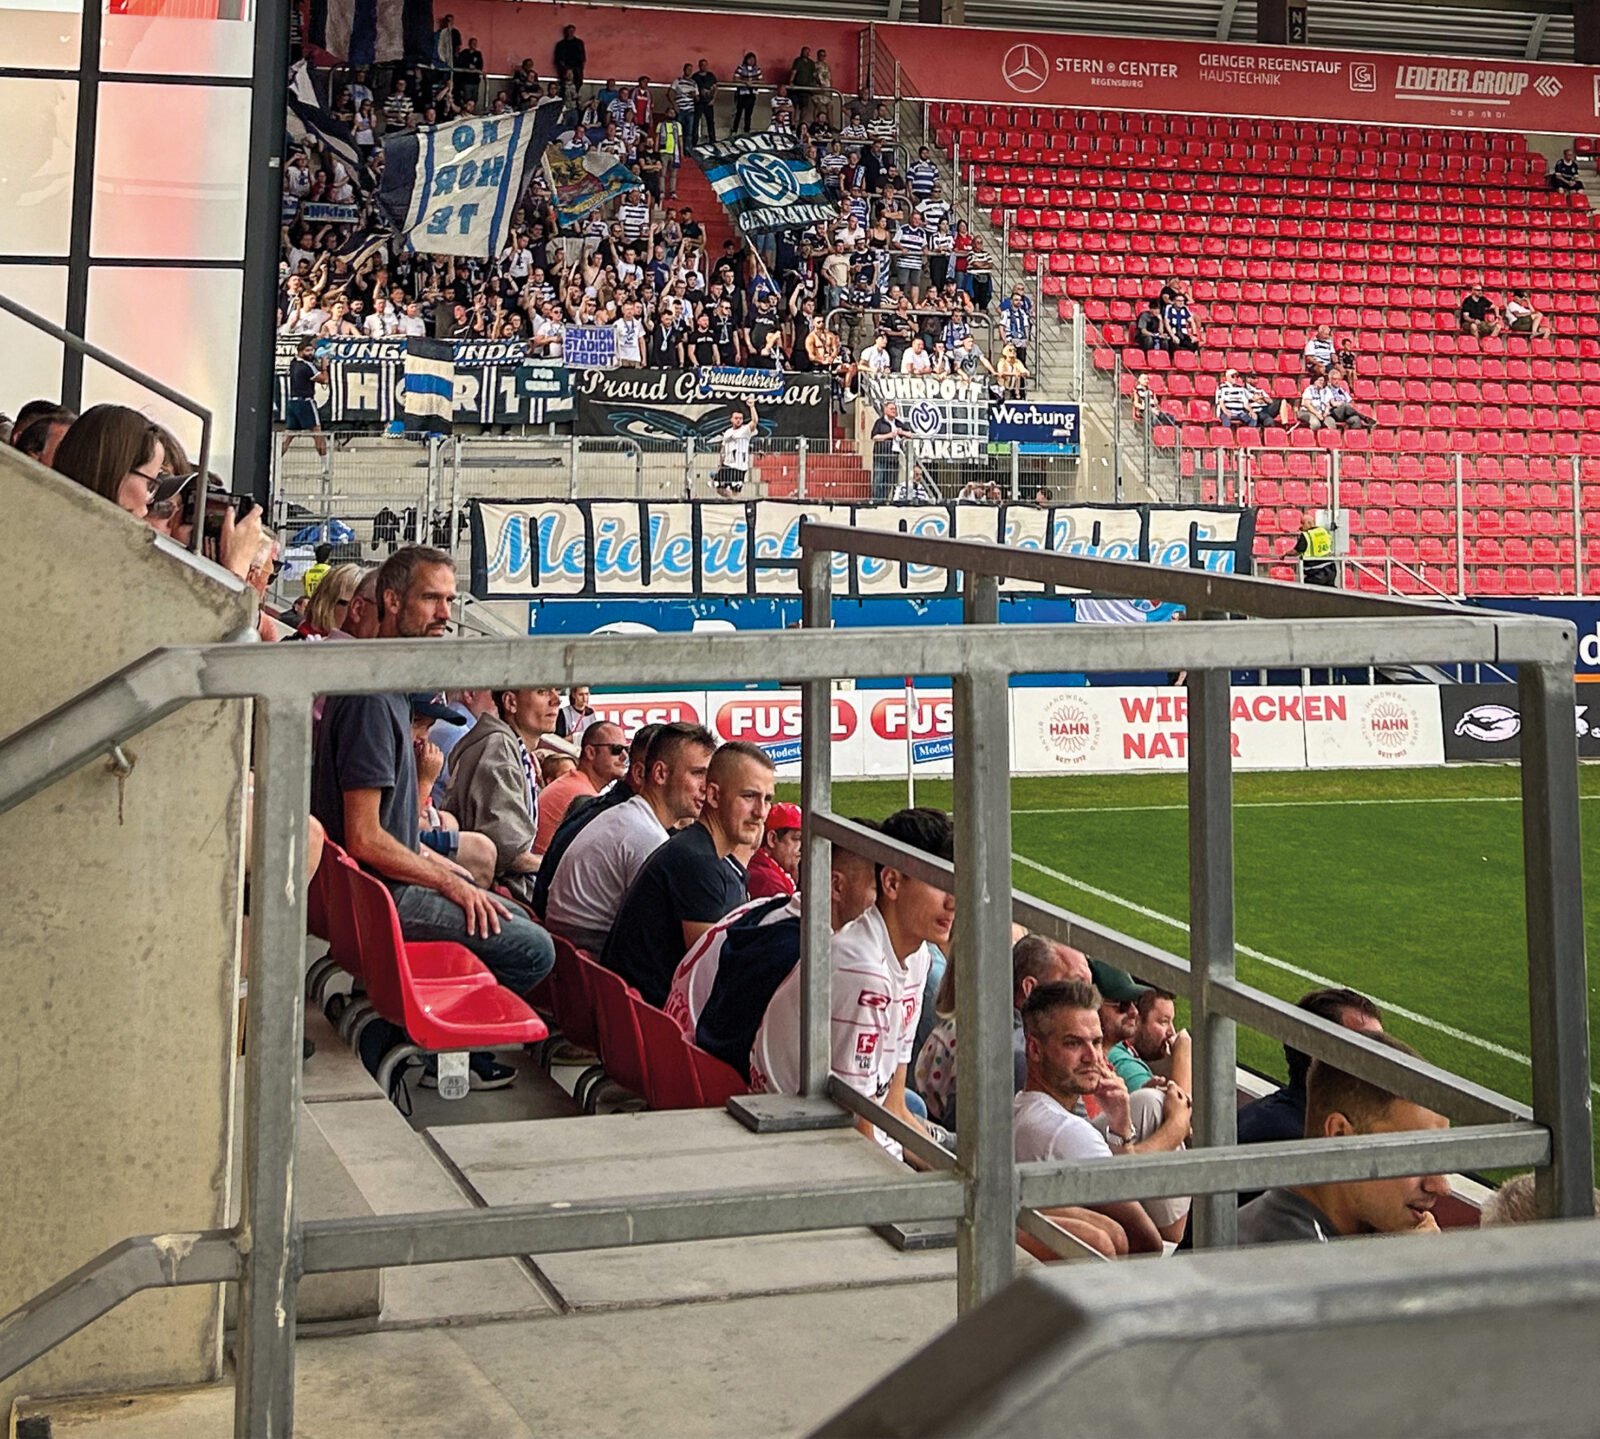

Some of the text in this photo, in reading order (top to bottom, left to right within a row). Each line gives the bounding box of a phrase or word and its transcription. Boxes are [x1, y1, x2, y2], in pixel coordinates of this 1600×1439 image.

[1055, 57, 1178, 78] STERN CENTER
[1198, 53, 1342, 74] GIENGER REGENSTAUF
[1091, 77, 1144, 88] REGENSBURG
[1199, 69, 1281, 86] HAUSTECHNIK
[1395, 65, 1528, 96] LEDERER.GROUP
[738, 203, 841, 232] GENERATION
[565, 327, 615, 340] SEKTION
[565, 339, 615, 353] STADION
[565, 351, 616, 367] VERBOT
[580, 369, 669, 400] Proud
[699, 365, 784, 388] Freundeskreis
[992, 404, 1076, 430] Werbung
[885, 702, 953, 734] FUS
[1230, 695, 1347, 722] ACKEN
[731, 706, 848, 738] FUSL
[1049, 722, 1090, 736] HAHN
[1371, 718, 1409, 731] HAHN
